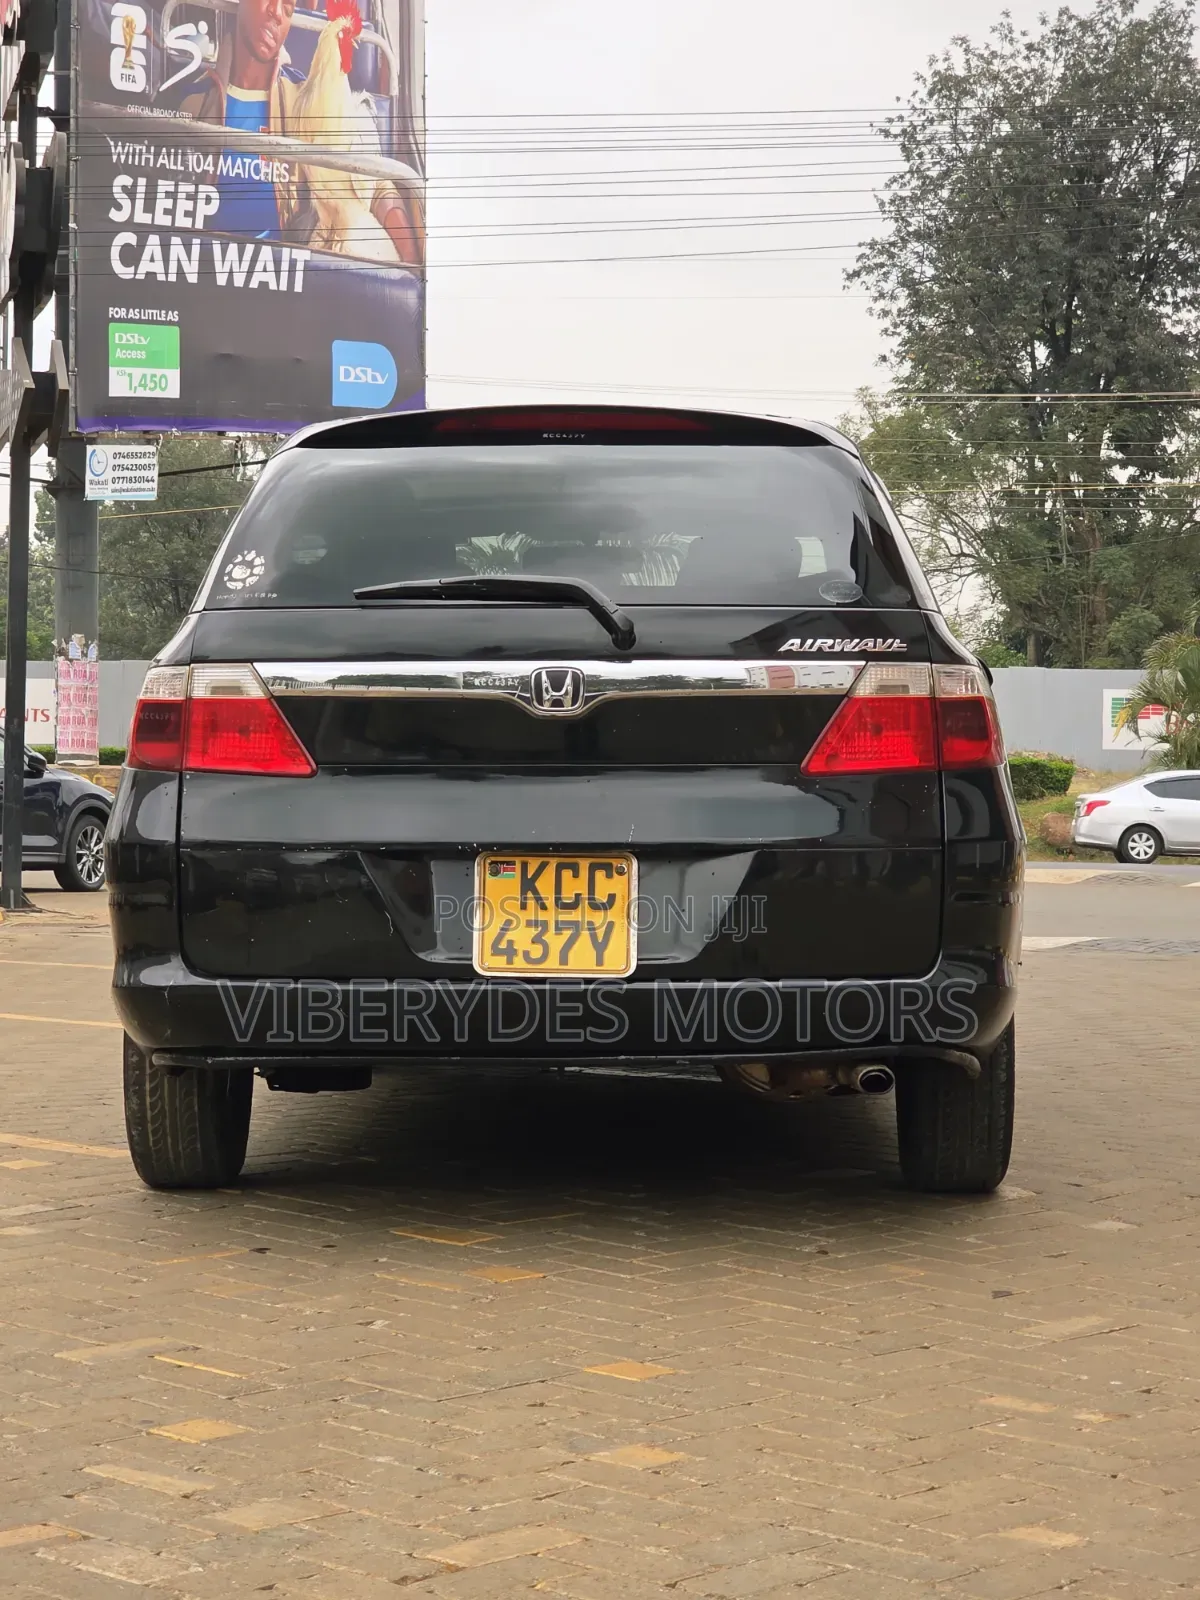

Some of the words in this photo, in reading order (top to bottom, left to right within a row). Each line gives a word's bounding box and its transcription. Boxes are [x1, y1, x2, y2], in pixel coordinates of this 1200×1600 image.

[120, 73, 137, 84] FIFA
[127, 104, 153, 116] OFFICIAL
[153, 107, 193, 121] BROADCASTER
[110, 141, 154, 168] WITH
[156, 146, 186, 172] ALL
[186, 150, 215, 174] 104
[216, 154, 290, 183] MATCHES
[108, 174, 220, 230] SLEEP
[110, 231, 201, 284] CAN
[212, 240, 311, 293] WAIT
[108, 307, 127, 319] FOR
[127, 308, 140, 319] AS
[141, 308, 166, 321] LITTLE
[166, 310, 179, 322] AS
[114, 332, 151, 345] DStv
[115, 347, 146, 359] Access
[127, 372, 169, 394] 1,450
[339, 365, 389, 385] DStv
[111, 476, 155, 485] 0771830144
[777, 638, 908, 652] AIRWAVE
[520, 861, 616, 911] KCC
[490, 919, 615, 966] 437Y
